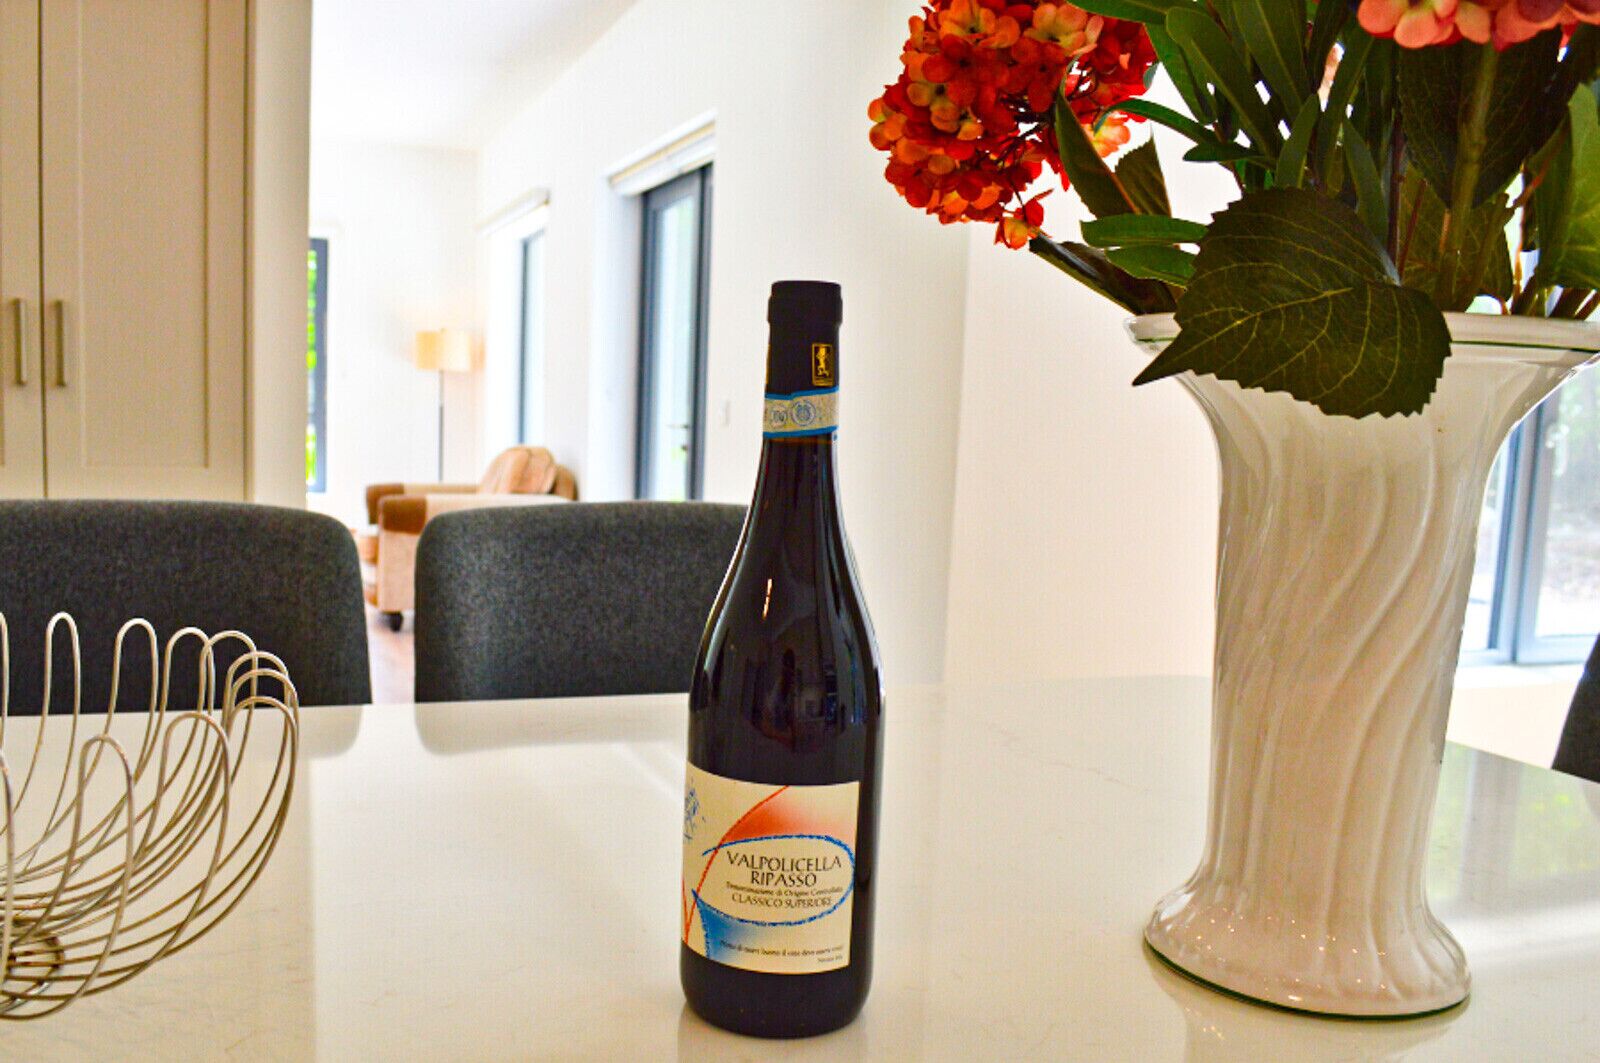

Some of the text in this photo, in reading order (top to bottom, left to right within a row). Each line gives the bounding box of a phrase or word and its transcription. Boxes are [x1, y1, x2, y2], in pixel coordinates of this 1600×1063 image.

[727, 850, 841, 872] VALPOLICELLA
[751, 870, 817, 888] RIPASSO
[731, 892, 832, 909] CLASSICO SUPERIORE
